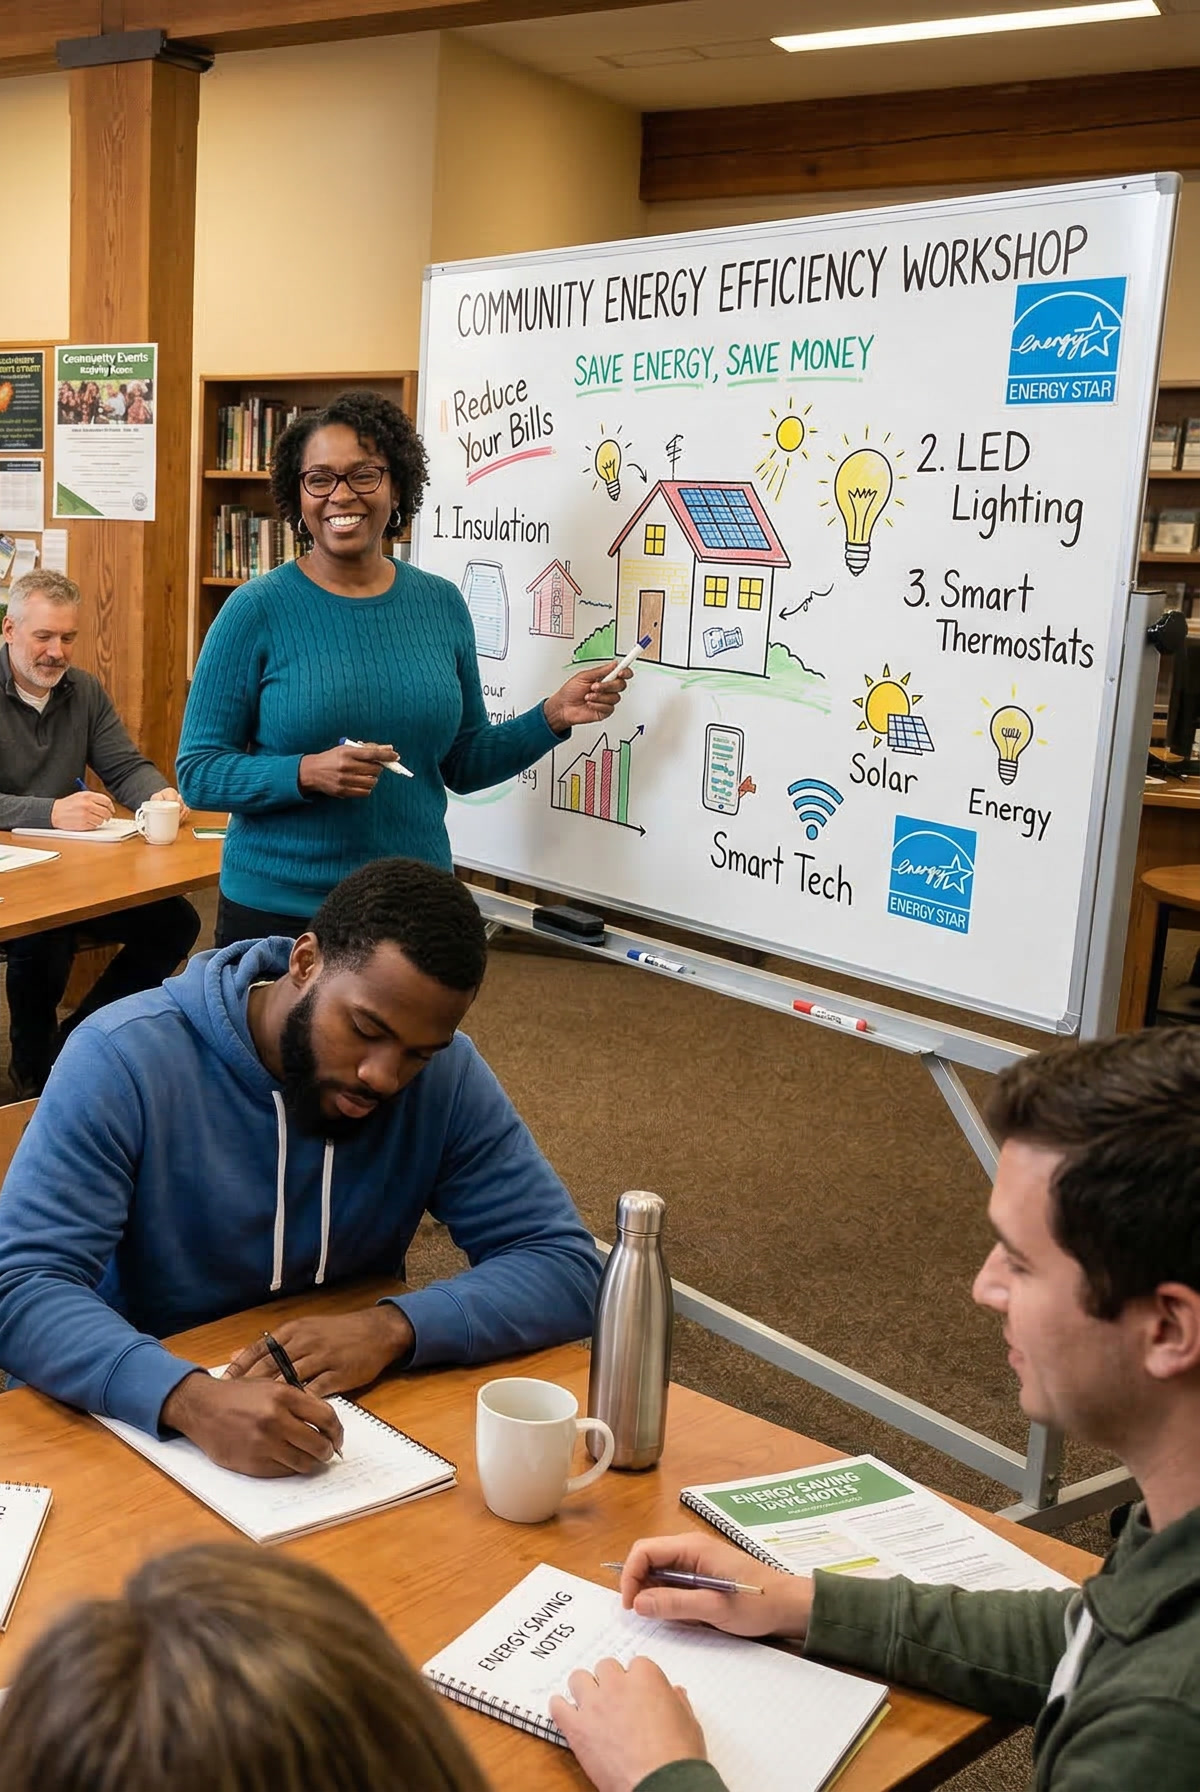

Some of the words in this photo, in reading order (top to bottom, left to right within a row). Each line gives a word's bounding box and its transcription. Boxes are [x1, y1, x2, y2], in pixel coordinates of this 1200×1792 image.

[457, 278, 595, 338] COMMUNITY
[604, 266, 707, 324] ENERGY
[719, 246, 888, 313] EFFICIENCY
[903, 224, 1088, 293] WORKSHOP
[574, 353, 624, 386] SAVE
[633, 346, 719, 383] ENERGY,
[726, 342, 781, 376] SAVE
[790, 335, 875, 371] MONEY
[1011, 334, 1086, 360] energy
[453, 378, 529, 427] Reduce
[1009, 381, 1069, 400] ENERGY
[1071, 380, 1112, 398] STAR
[458, 430, 503, 469] Your
[509, 404, 555, 449] Bills
[916, 433, 945, 474] 2.
[956, 431, 1031, 472] LED
[951, 483, 1084, 547] Lighting
[903, 568, 931, 608] 3.
[940, 569, 1035, 613] Smart
[936, 618, 1094, 669] Thermostats
[848, 752, 919, 795] Solar
[968, 788, 1052, 842] Energy
[709, 831, 784, 886] Smart
[793, 851, 853, 907] Tech
[890, 897, 935, 920] ENERGY
[936, 909, 966, 929] STAR
[730, 1485, 796, 1504] ENERGY
[797, 1472, 861, 1493] SAVING
[478, 1629, 531, 1671] ENERGY
[523, 1591, 573, 1632] SAVING
[530, 1623, 575, 1659] NOTES
